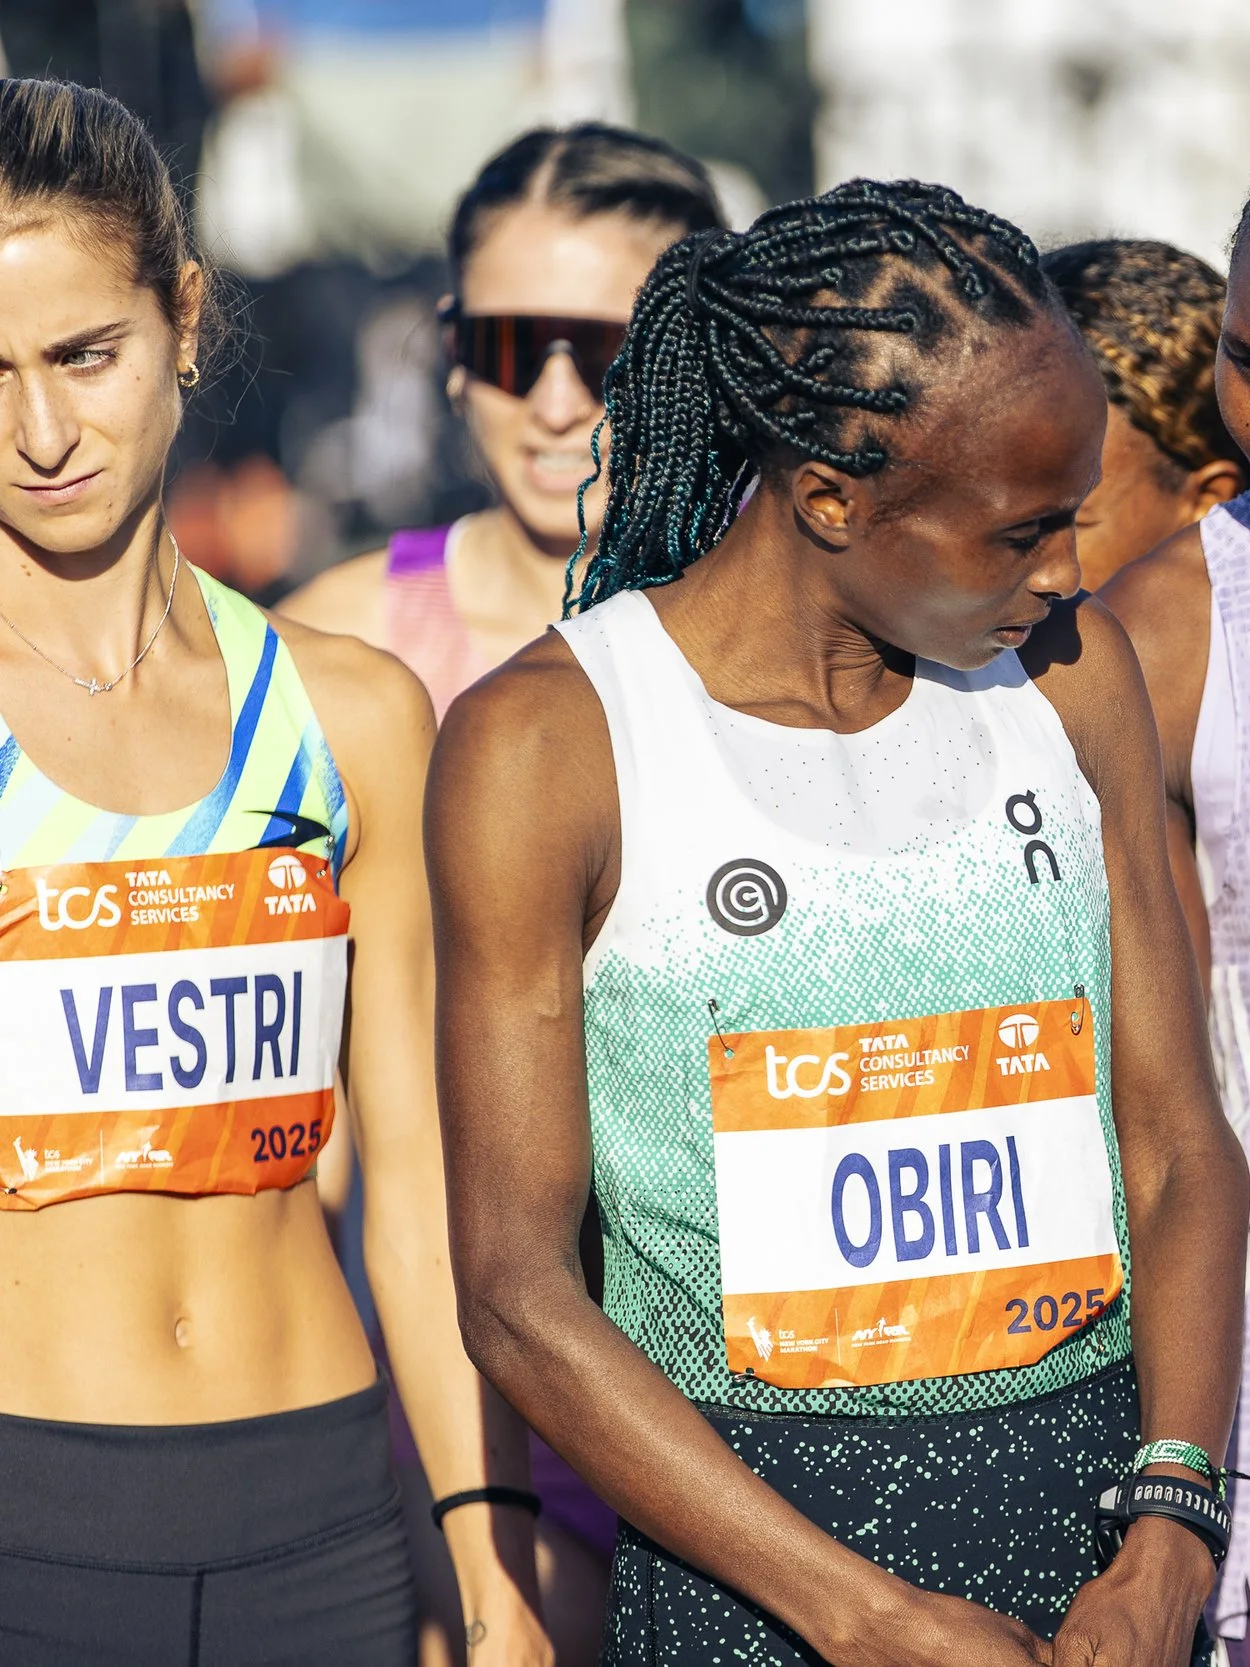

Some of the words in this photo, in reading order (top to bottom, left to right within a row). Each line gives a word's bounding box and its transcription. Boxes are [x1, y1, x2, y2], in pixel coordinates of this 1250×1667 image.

[125, 870, 171, 887] TATA
[37, 878, 122, 931] tcs
[128, 883, 235, 907] CONSULTANCY
[264, 893, 316, 915] TATA
[131, 907, 199, 925] SERVICES
[60, 971, 302, 1094] VESTRI
[859, 1034, 909, 1053] TATA
[860, 1045, 969, 1072] CONSULTANCY
[996, 1053, 1050, 1076] TATA
[765, 1045, 851, 1099] tcs
[861, 1070, 934, 1093] SERVICES
[251, 1120, 322, 1162] 2025
[831, 1135, 1029, 1268] OBIRI
[1005, 1288, 1105, 1335] 2025
